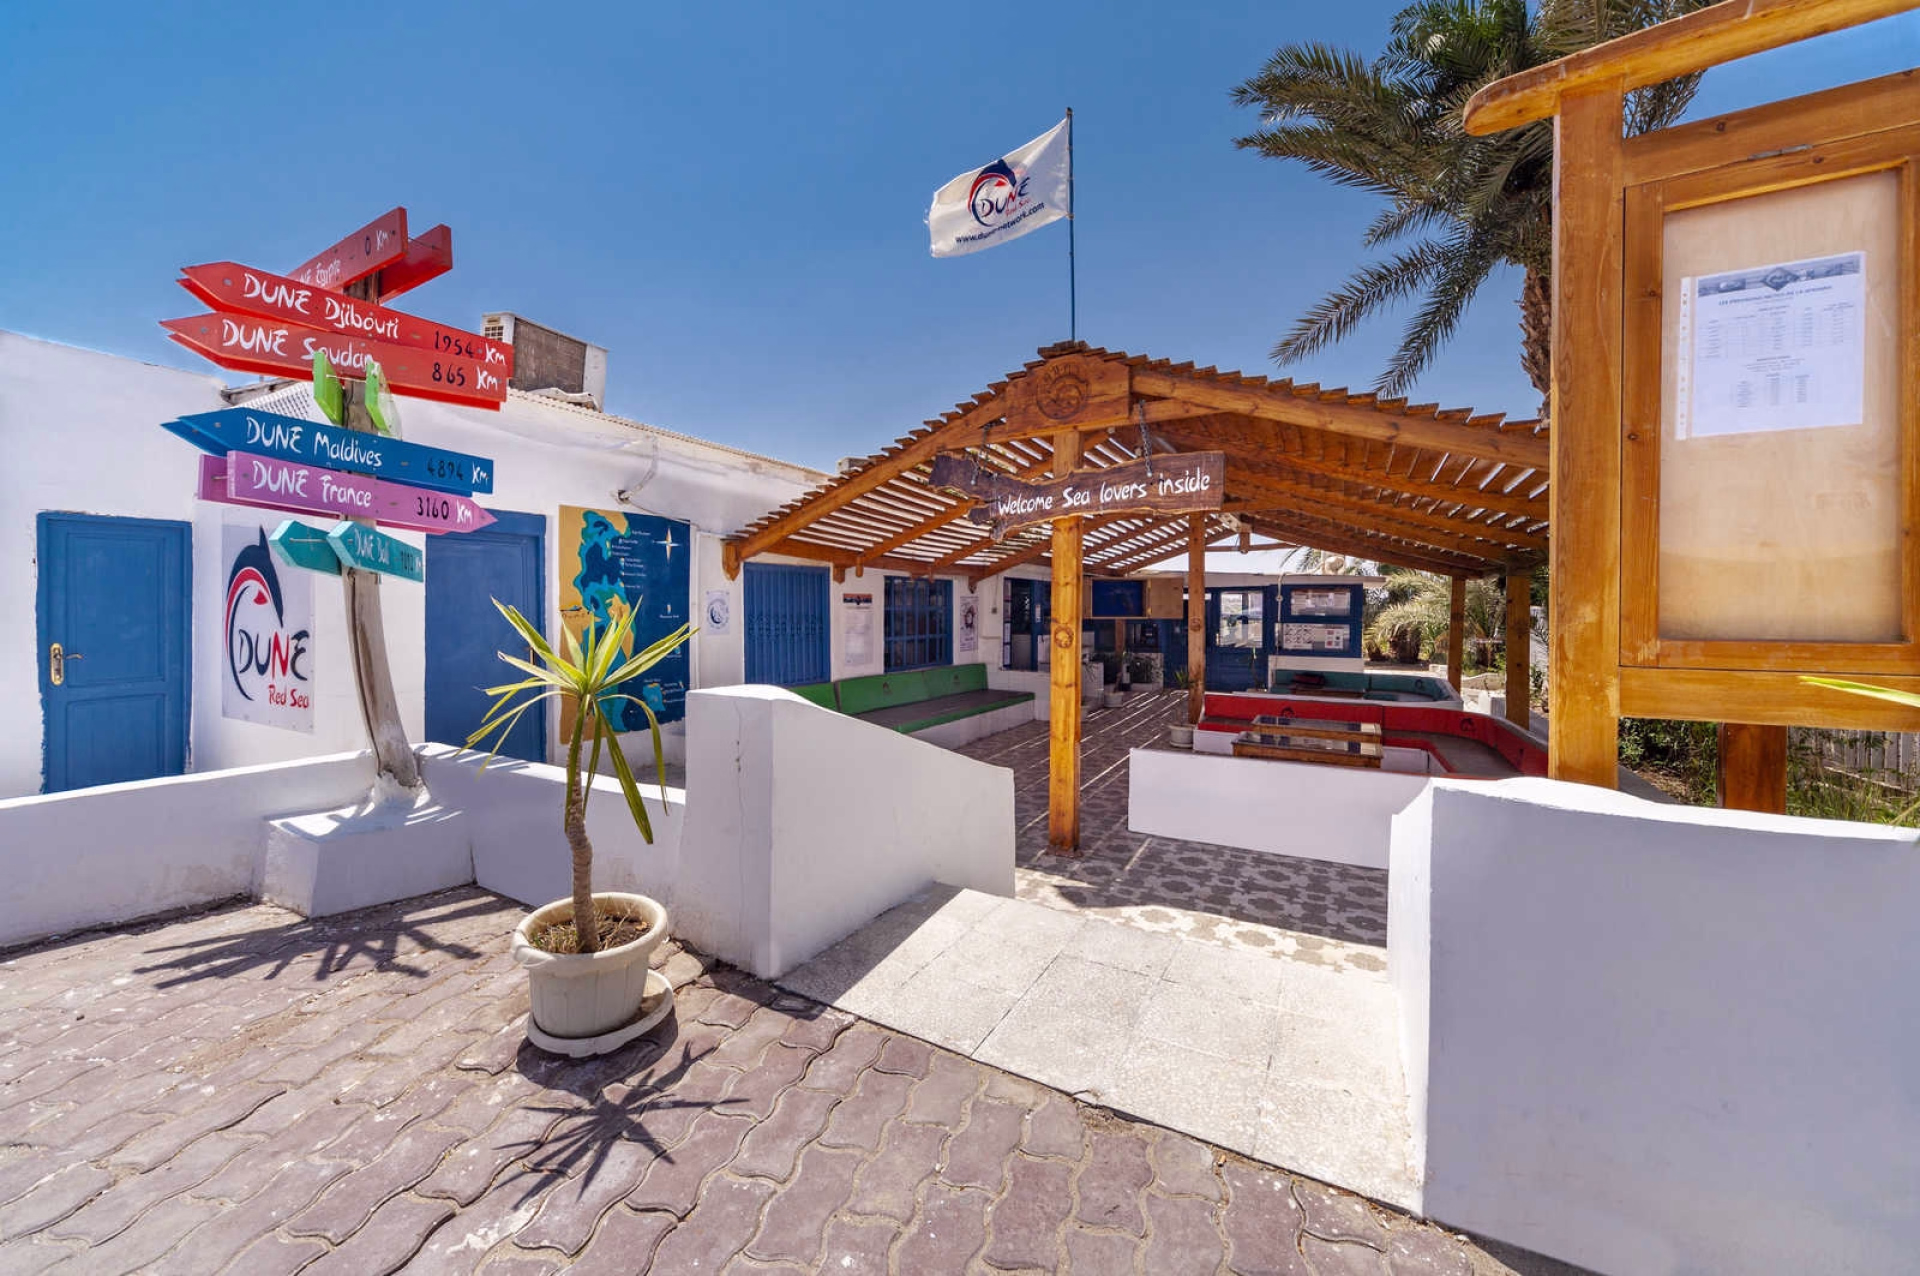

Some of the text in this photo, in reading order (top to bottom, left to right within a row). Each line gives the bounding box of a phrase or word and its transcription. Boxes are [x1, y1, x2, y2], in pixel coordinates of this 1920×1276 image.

[980, 177, 1030, 217] DUNE
[244, 273, 312, 315] DUNE
[325, 297, 399, 339] Djibouti
[435, 331, 474, 358] 1954
[222, 319, 289, 356] DUNE
[432, 362, 466, 387] 865
[246, 416, 303, 453] DUNE
[314, 431, 383, 468] Maldives
[252, 460, 309, 498] DUNE
[320, 475, 372, 508] France
[417, 496, 449, 519] 3160
[1062, 487, 1090, 508] Sea
[1158, 467, 1210, 496] inside
[238, 628, 309, 682] DUNE
[268, 684, 309, 709] Red Sea
